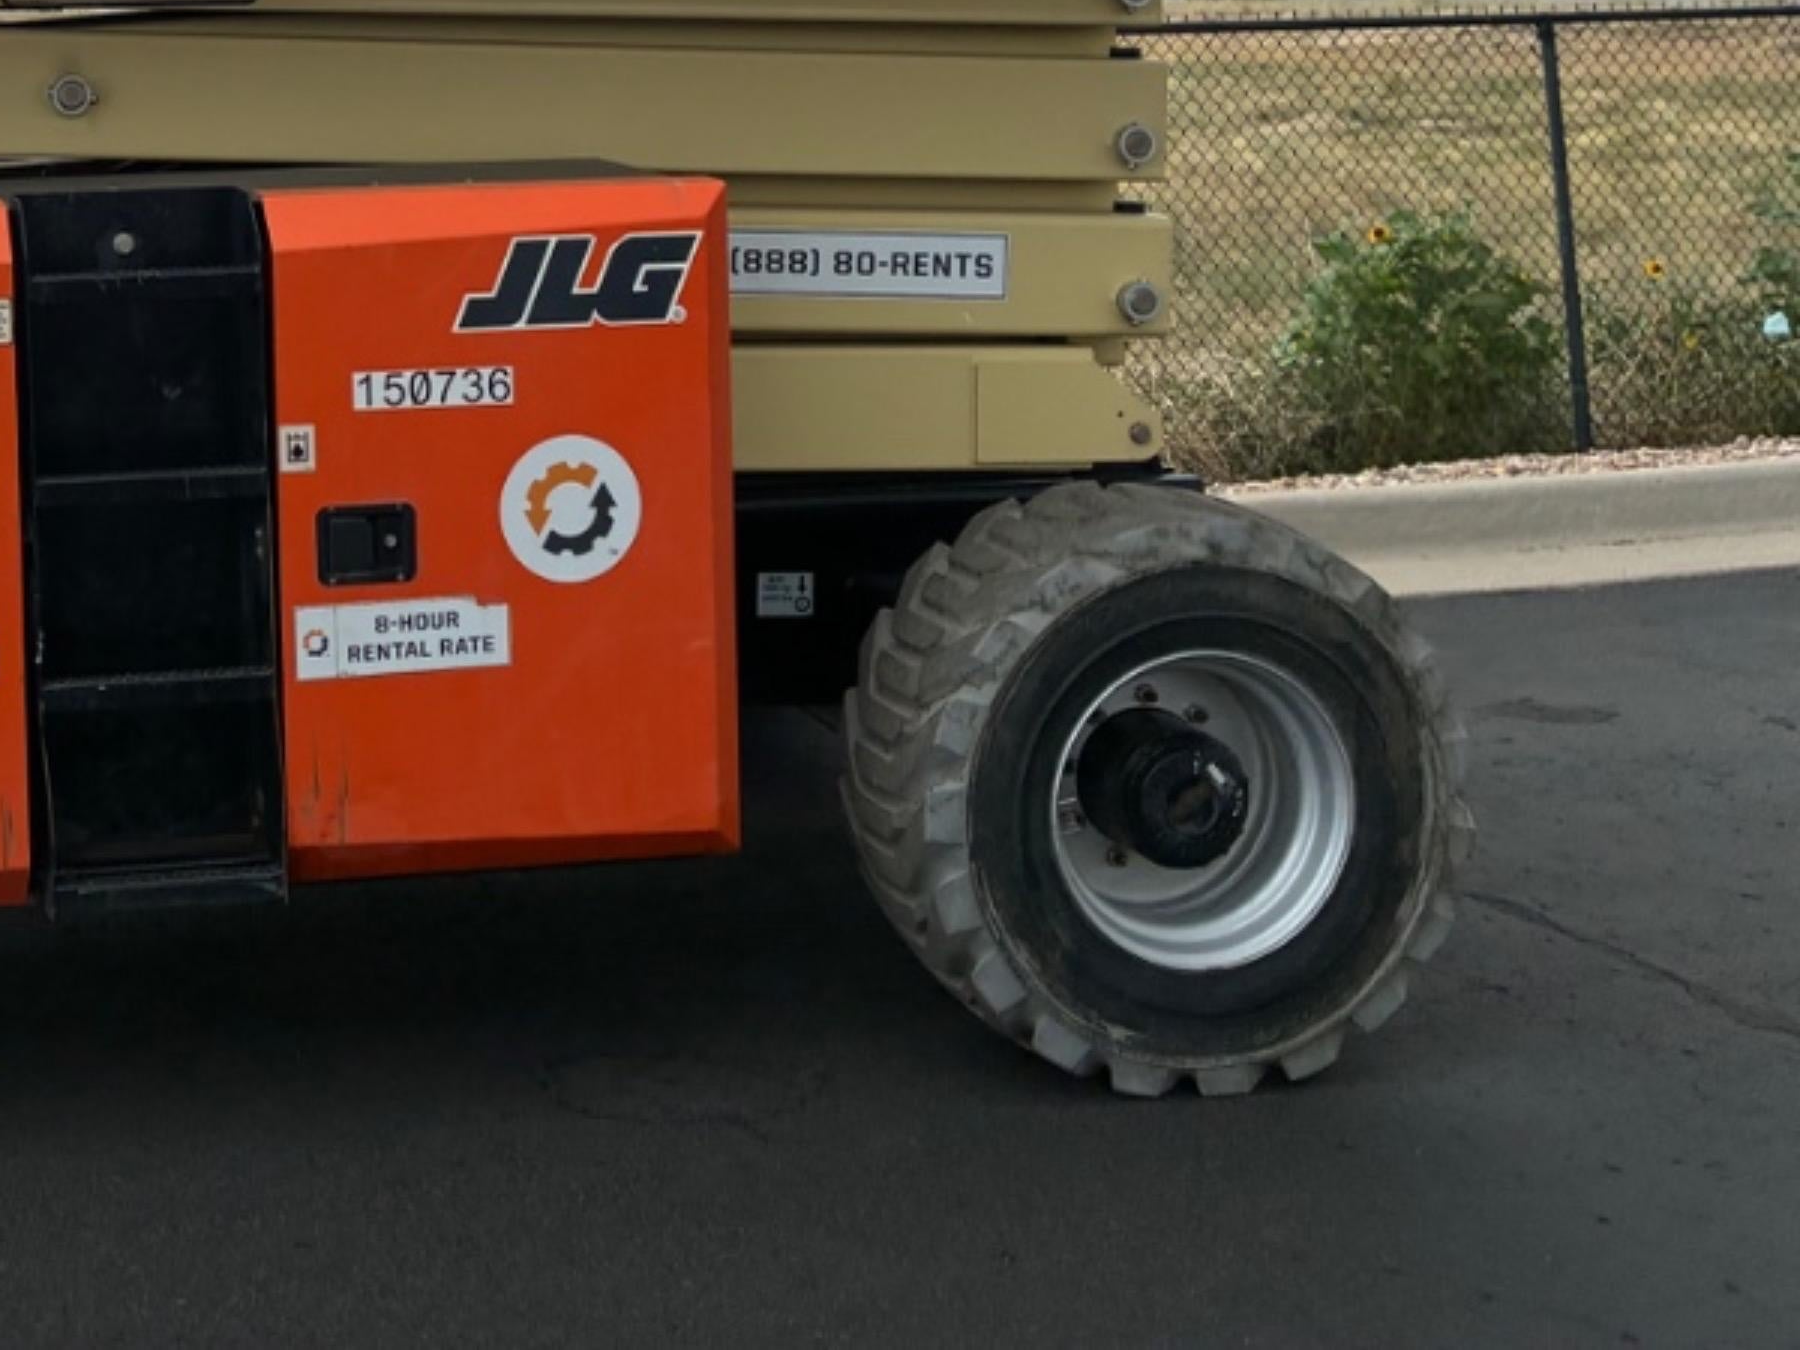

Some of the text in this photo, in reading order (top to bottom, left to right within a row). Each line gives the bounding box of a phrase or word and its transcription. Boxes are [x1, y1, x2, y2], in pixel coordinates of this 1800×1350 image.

[731, 246, 994, 278] (888) 80-RENTS
[453, 231, 702, 333] JLG
[357, 367, 512, 408] 150736
[374, 610, 460, 634] 8-HOUR
[347, 635, 496, 664] RENTAL RATE
